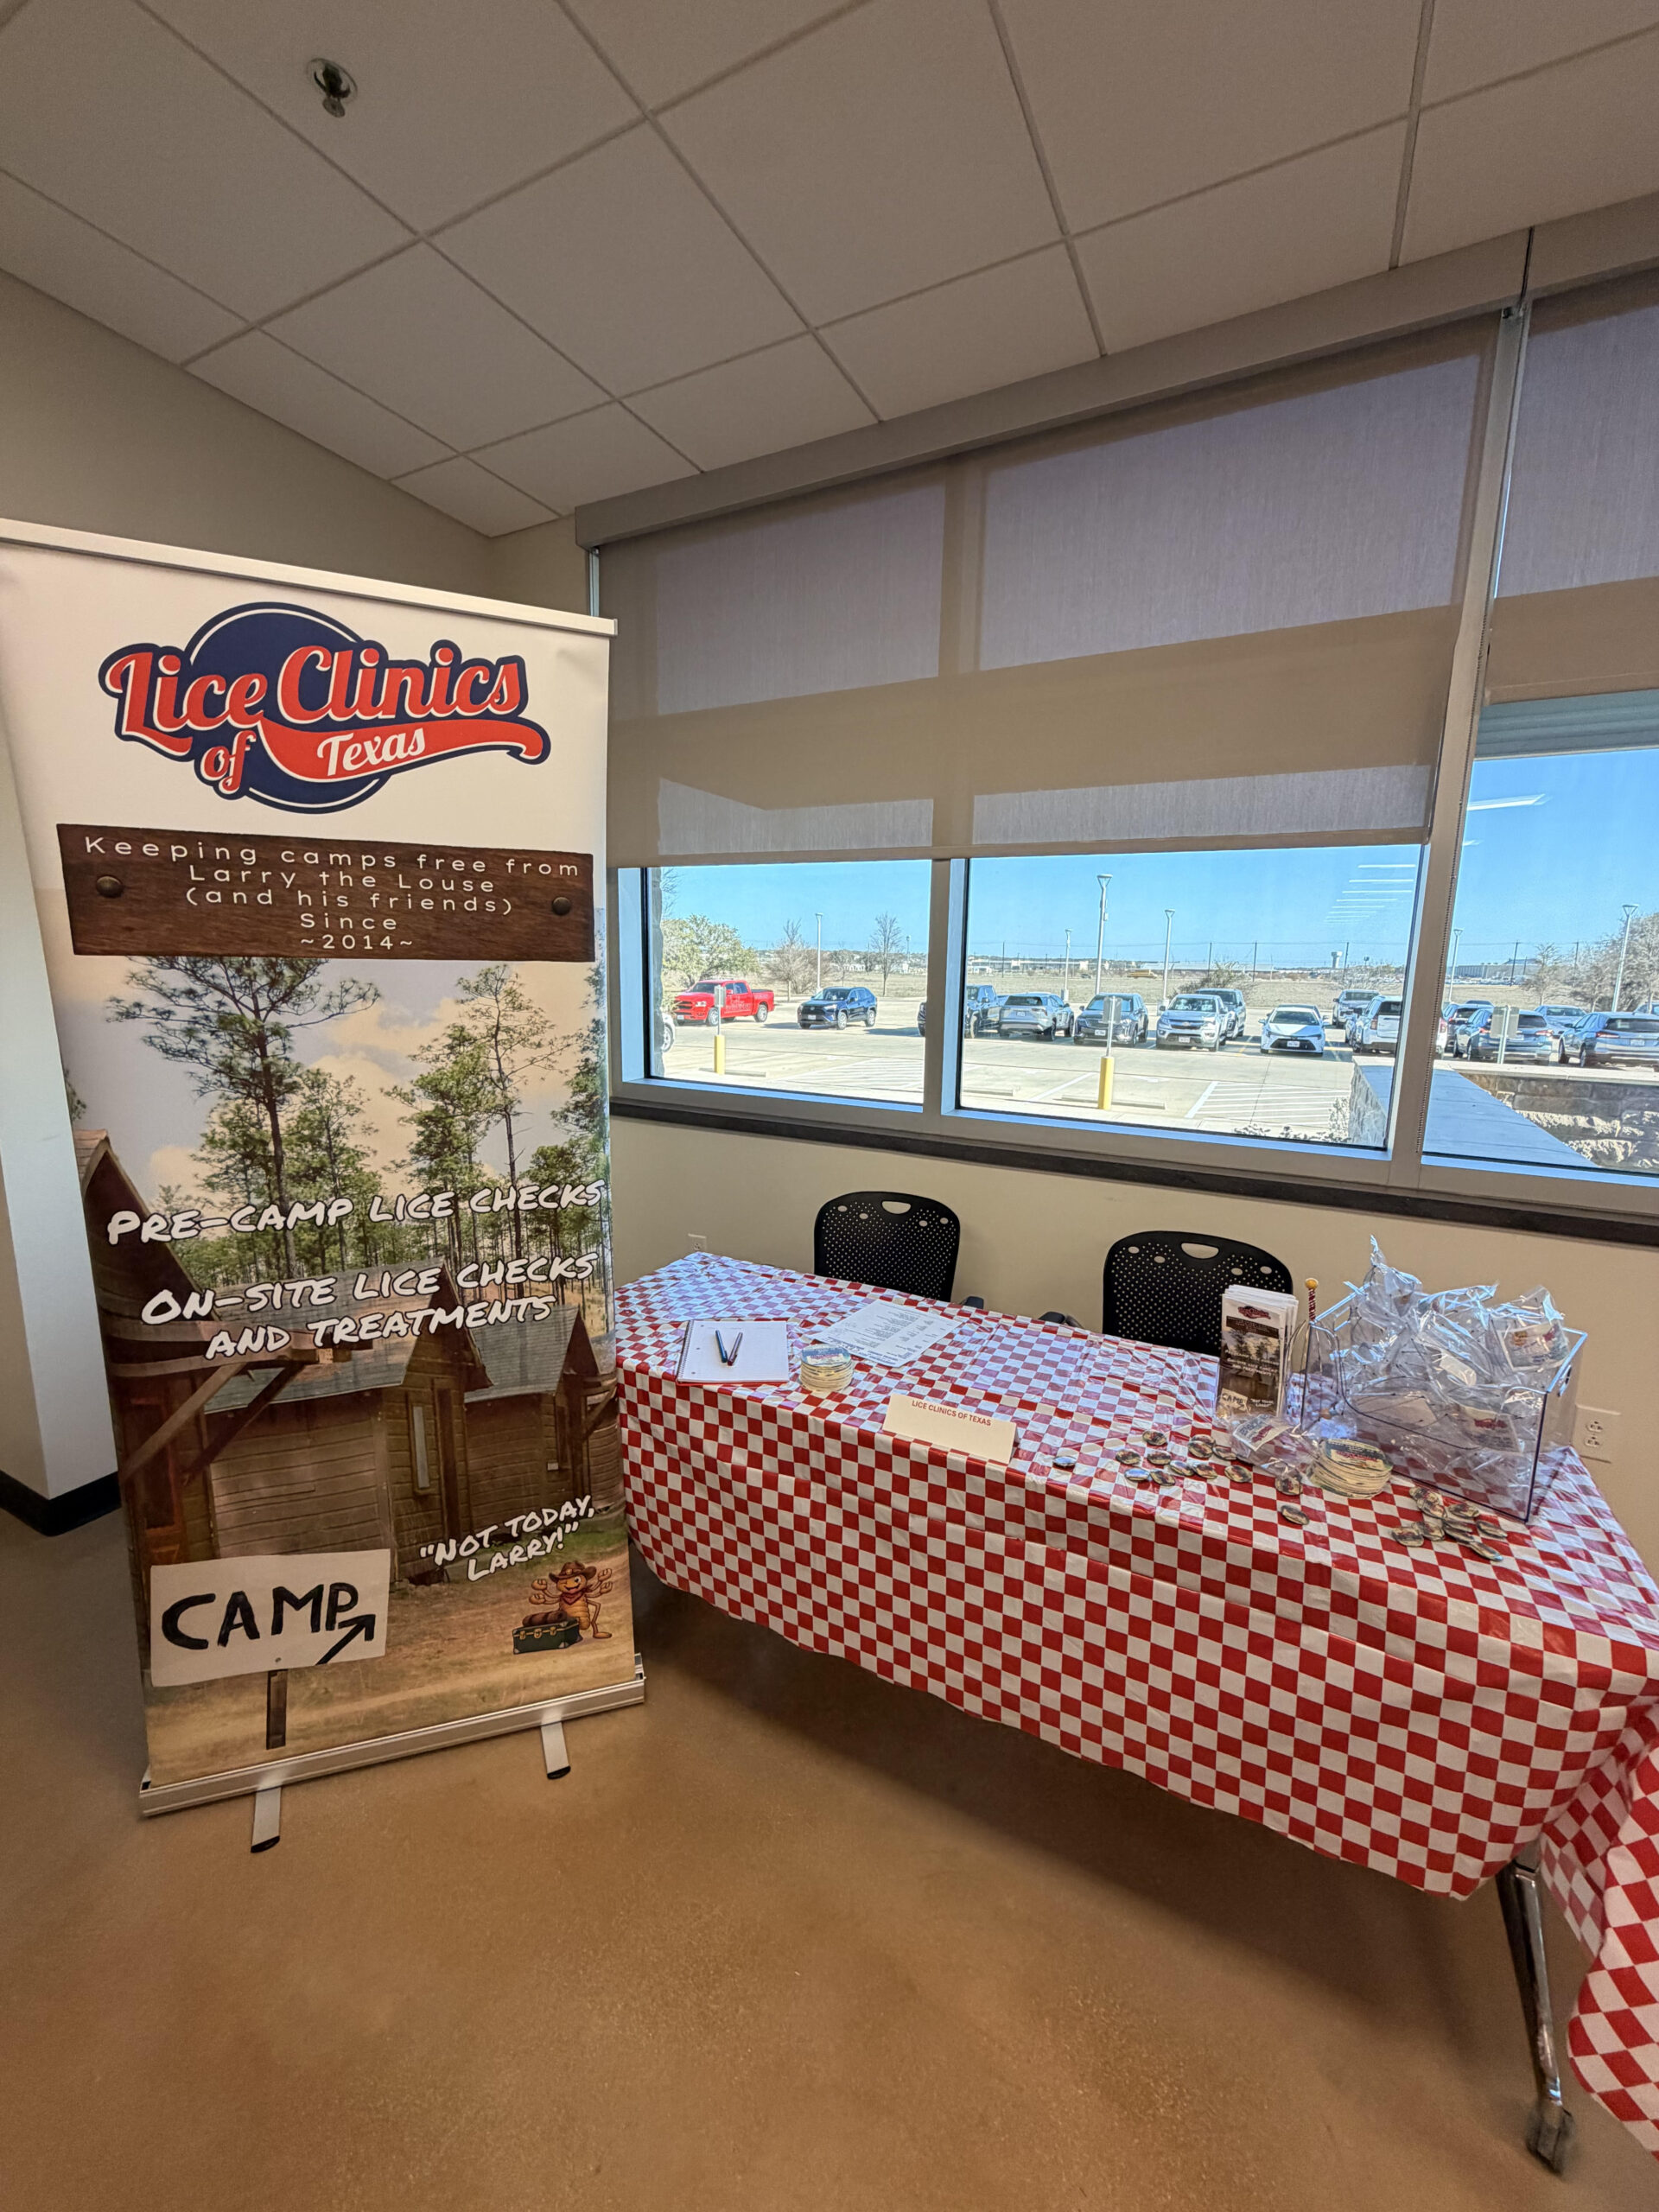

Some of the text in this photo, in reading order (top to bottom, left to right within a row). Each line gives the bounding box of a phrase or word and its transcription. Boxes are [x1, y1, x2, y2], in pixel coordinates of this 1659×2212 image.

[105, 645, 522, 755] Lice Clinics
[200, 727, 427, 795] of Texas
[84, 836, 580, 877] Keeping camps free from
[189, 865, 495, 893] Larry the Louse
[185, 886, 513, 916] (and his friends)
[299, 912, 397, 931] Since
[299, 933, 414, 951] ~2014~
[107, 1179, 605, 1246] PRE-CAMP LICE CHECKS
[140, 1252, 600, 1325] ON-SITE LICE CHECKS
[205, 1294, 556, 1360] AND TREATMENTS
[912, 1400, 927, 1410] LICE
[928, 1403, 957, 1417] CLINICS
[969, 1414, 992, 1427] TEXAS
[503, 1494, 595, 1539] TODAY,
[160, 1581, 359, 1651] CAMP
